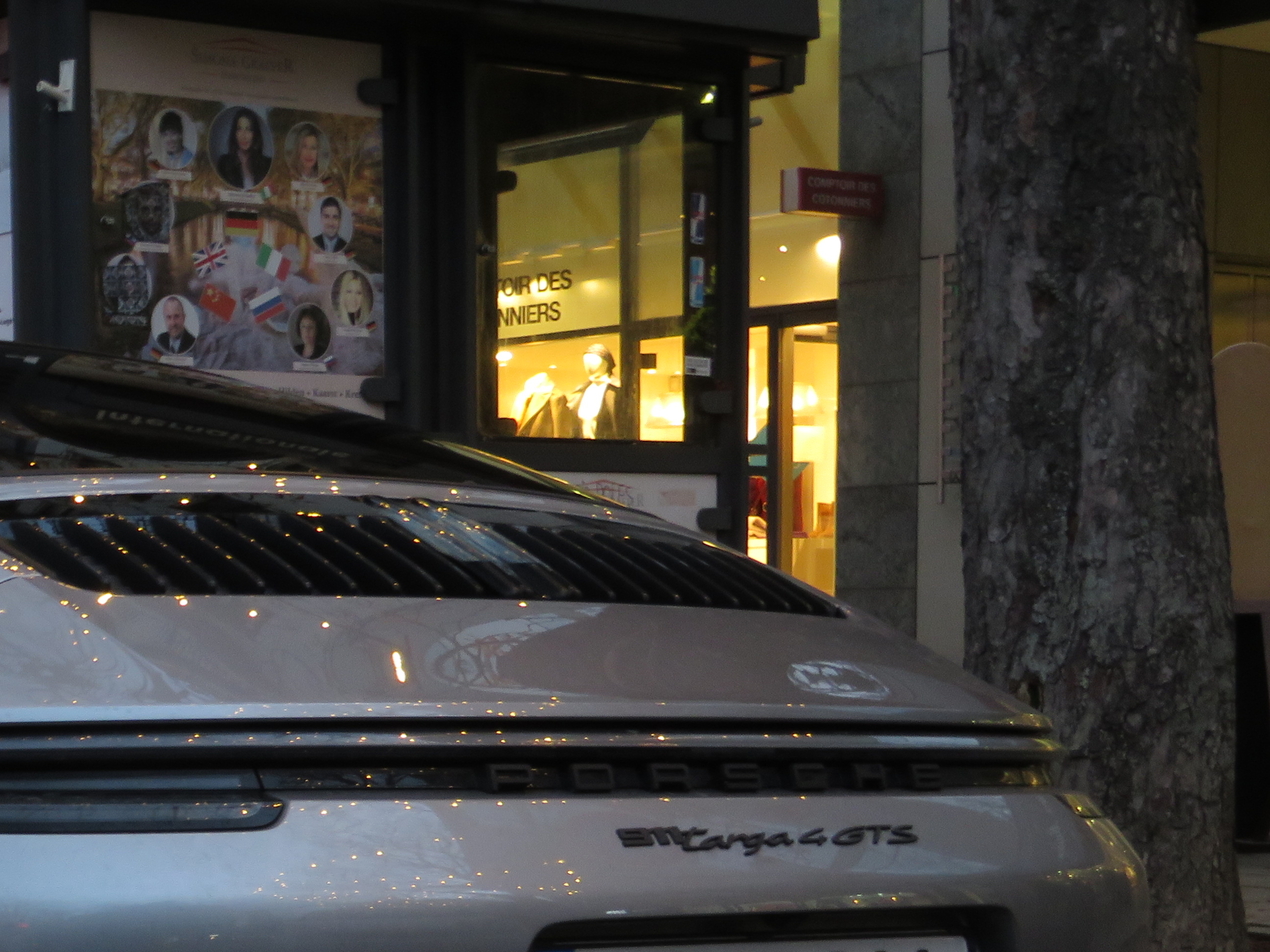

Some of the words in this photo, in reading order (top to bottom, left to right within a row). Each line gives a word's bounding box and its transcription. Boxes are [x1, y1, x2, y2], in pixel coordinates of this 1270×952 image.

[807, 176, 855, 191] COMPTOIR
[857, 181, 877, 194] DES
[811, 193, 872, 210] COTONNIERS
[537, 268, 573, 293] DES
[489, 763, 943, 792] PORSCHE
[798, 827, 830, 847] 4
[832, 824, 920, 847] GTS
